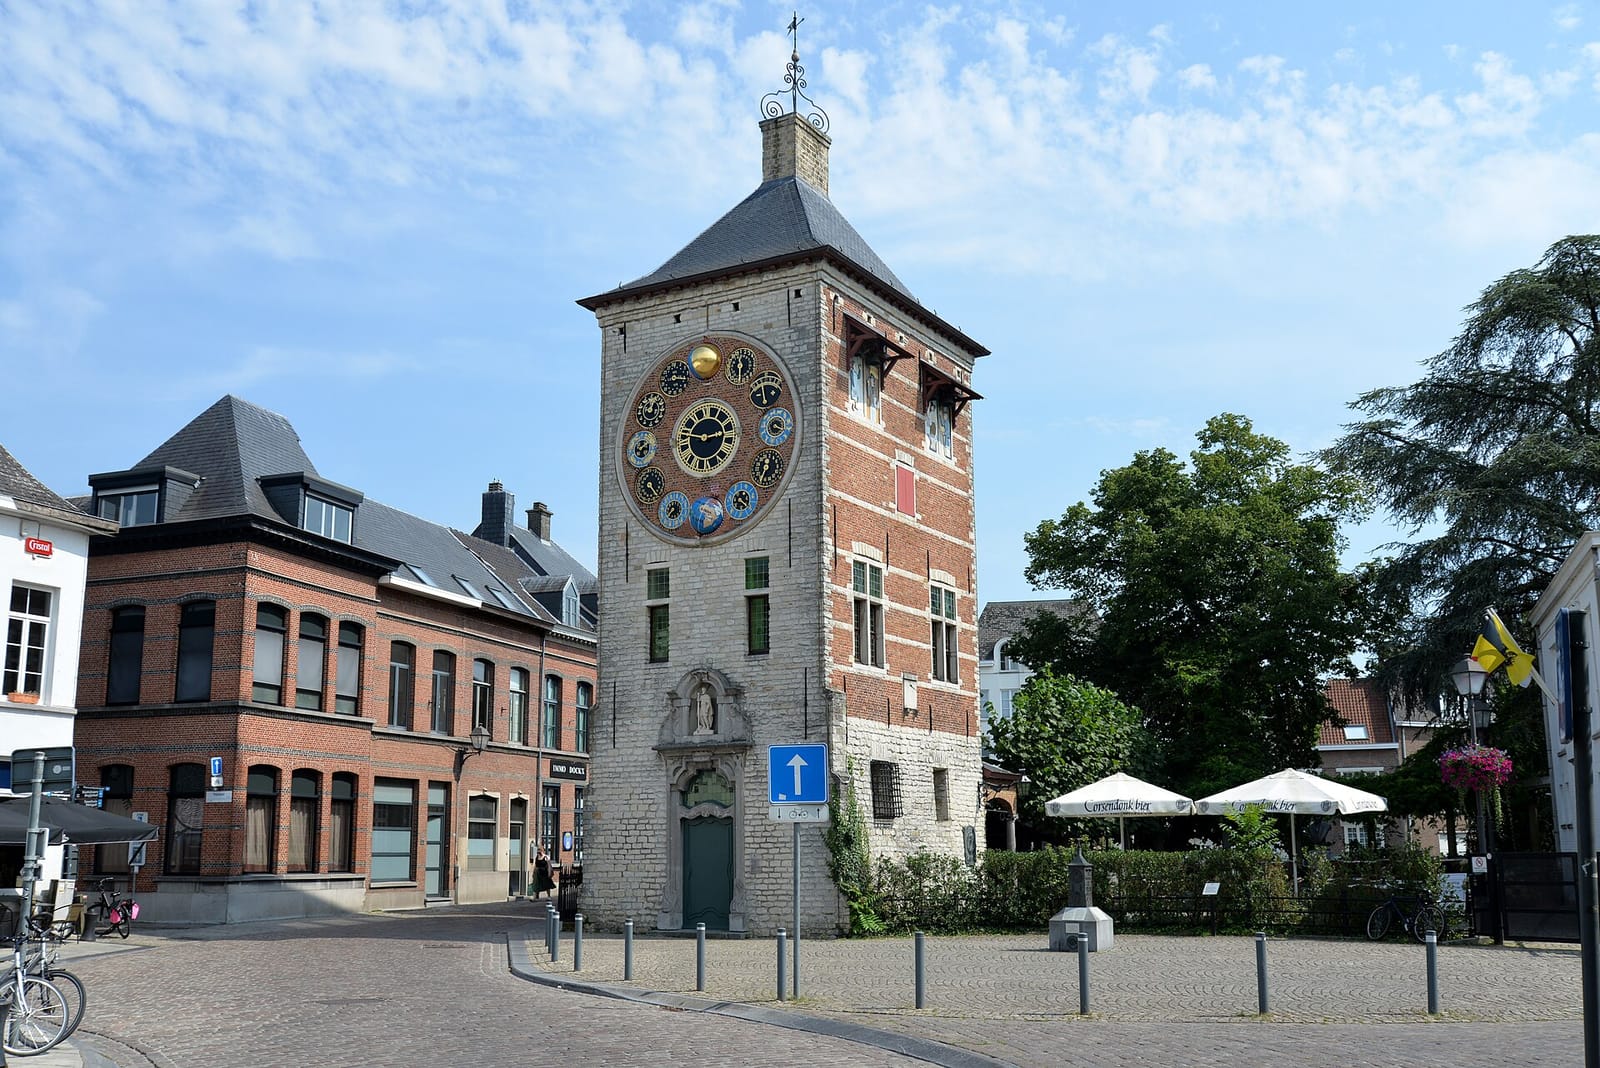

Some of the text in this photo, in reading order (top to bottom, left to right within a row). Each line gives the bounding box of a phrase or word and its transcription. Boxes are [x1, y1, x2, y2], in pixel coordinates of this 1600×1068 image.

[1084, 799, 1152, 812] Corsendonk bier
[1280, 800, 1296, 811] bier
